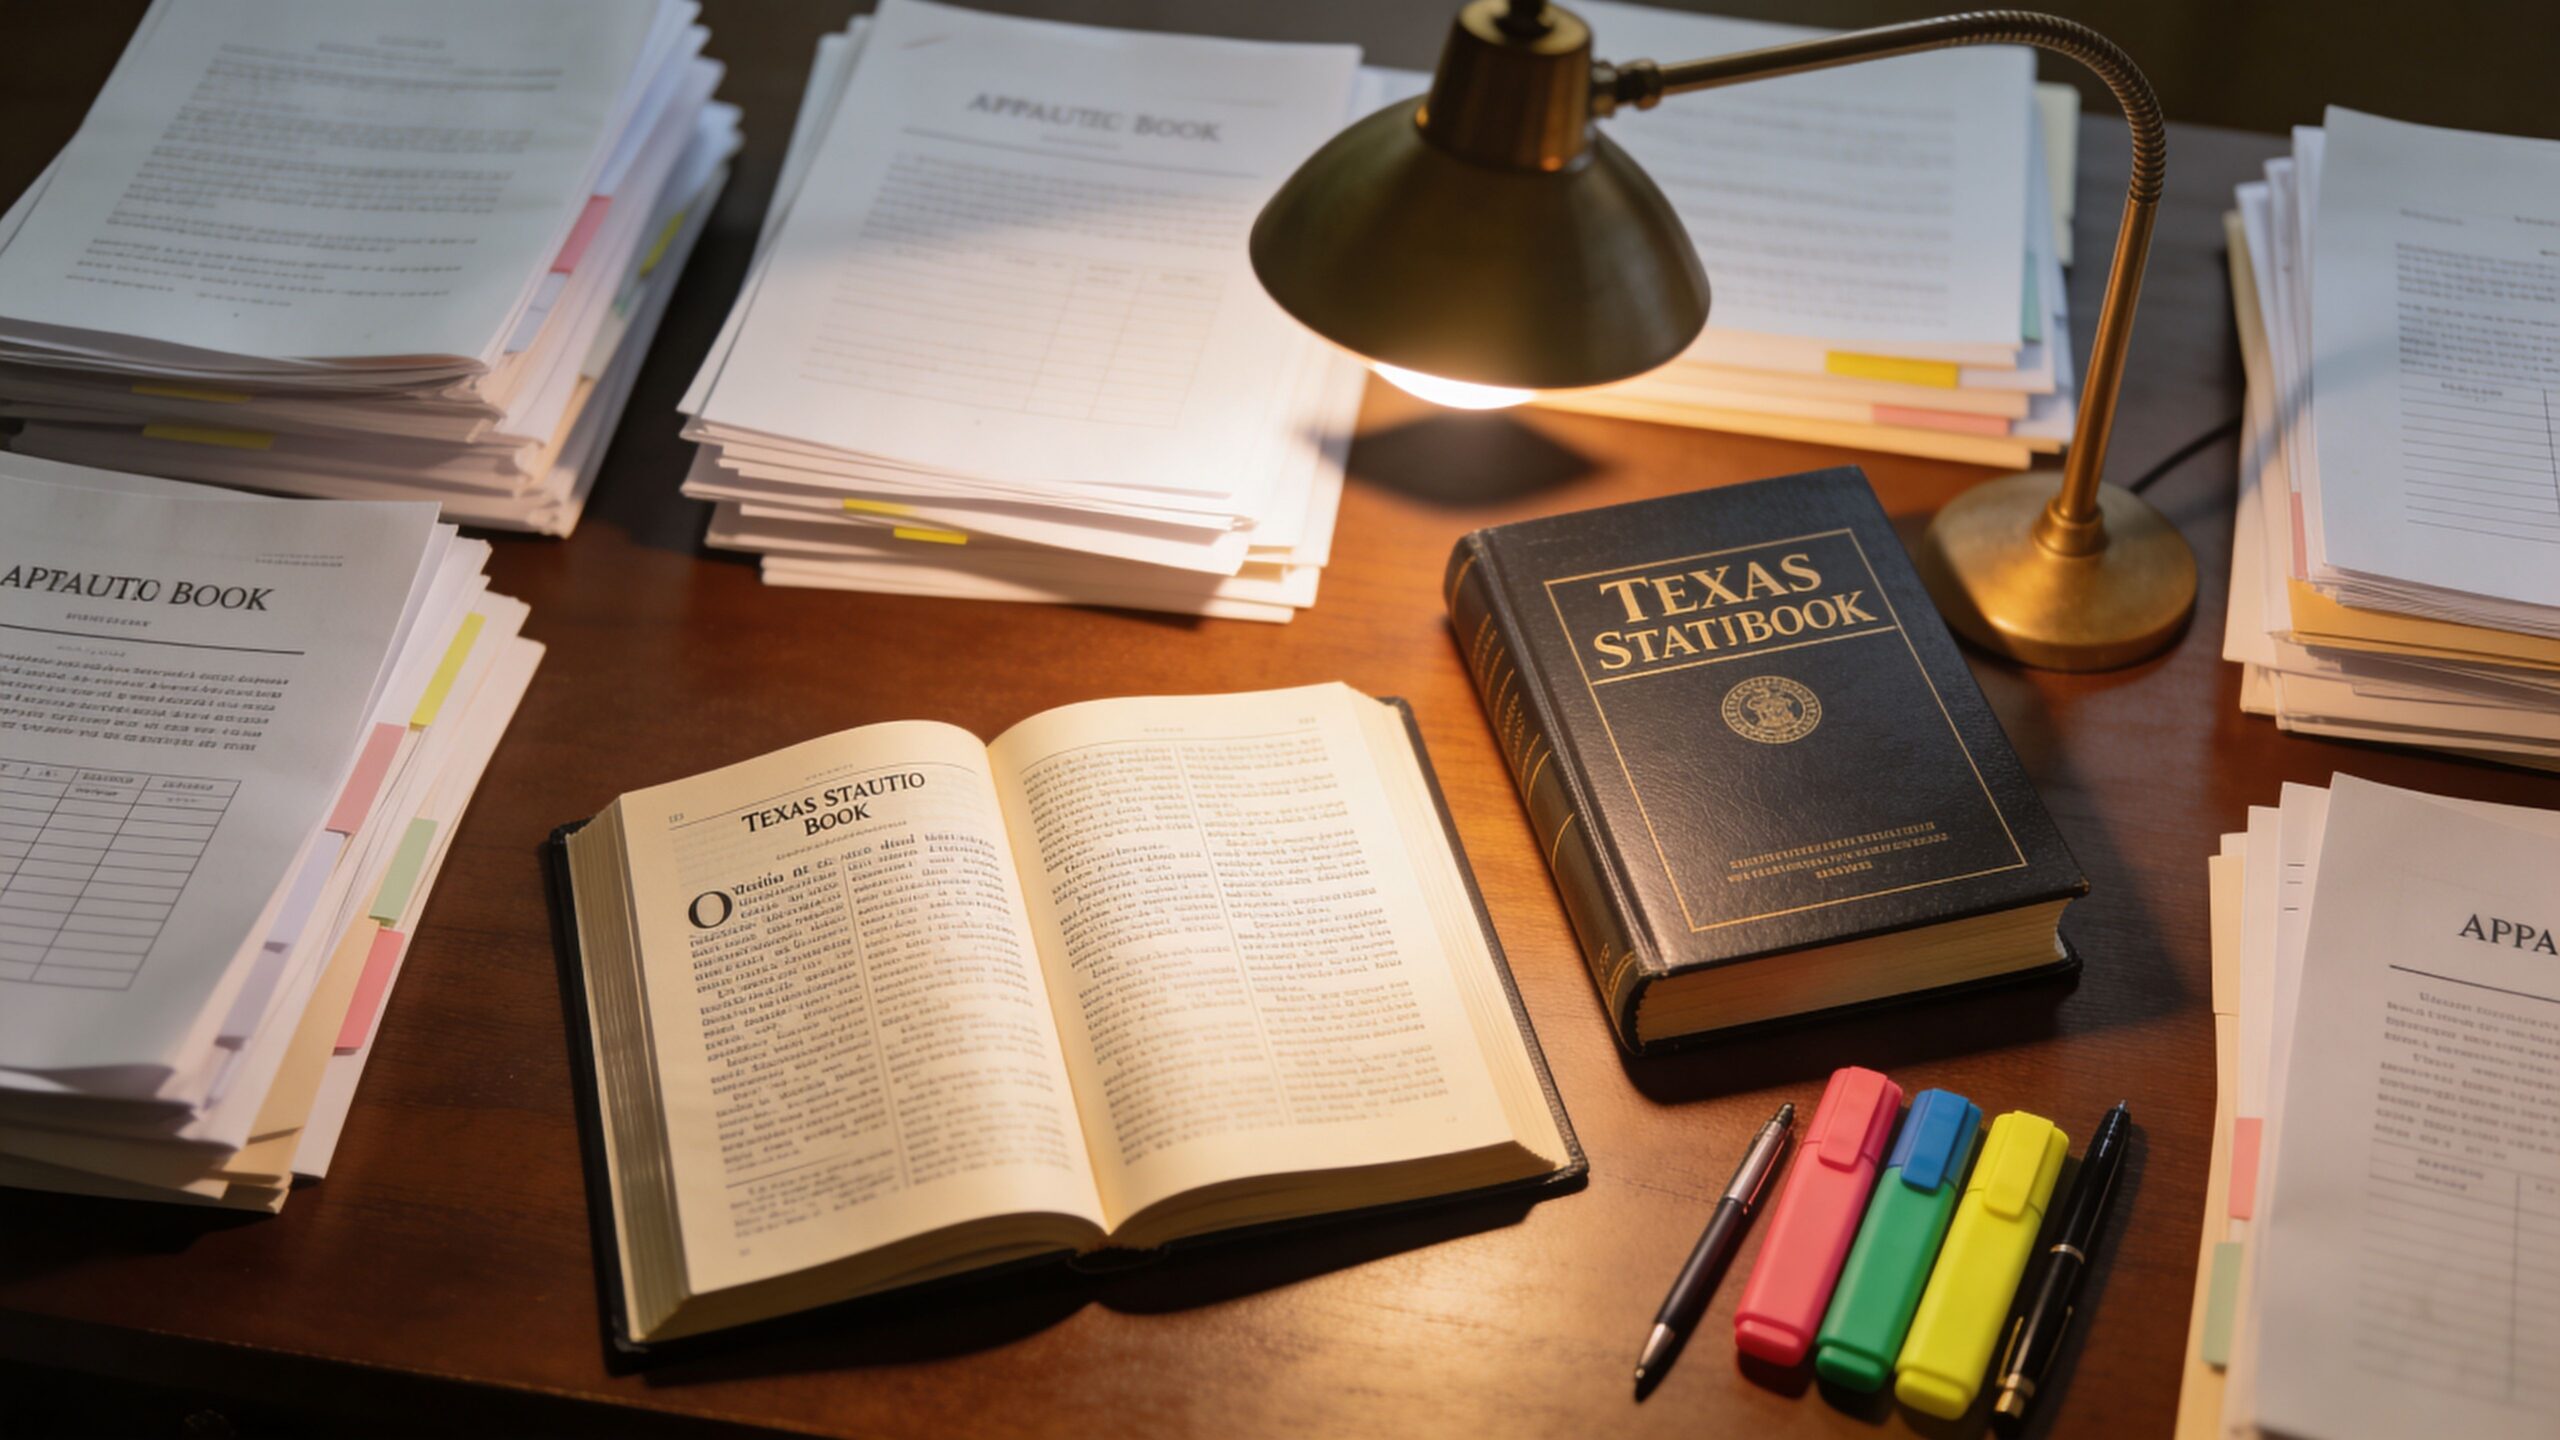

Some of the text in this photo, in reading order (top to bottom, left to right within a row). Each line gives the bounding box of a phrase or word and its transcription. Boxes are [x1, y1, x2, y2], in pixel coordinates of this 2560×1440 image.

[1133, 114, 1222, 143] BOOK
[168, 581, 275, 611] BOOK
[1599, 553, 1822, 624] TEXAS
[741, 772, 926, 833] TEXAS STAUTIO
[804, 803, 871, 837] BOOK
[2457, 913, 2559, 956] APPA
